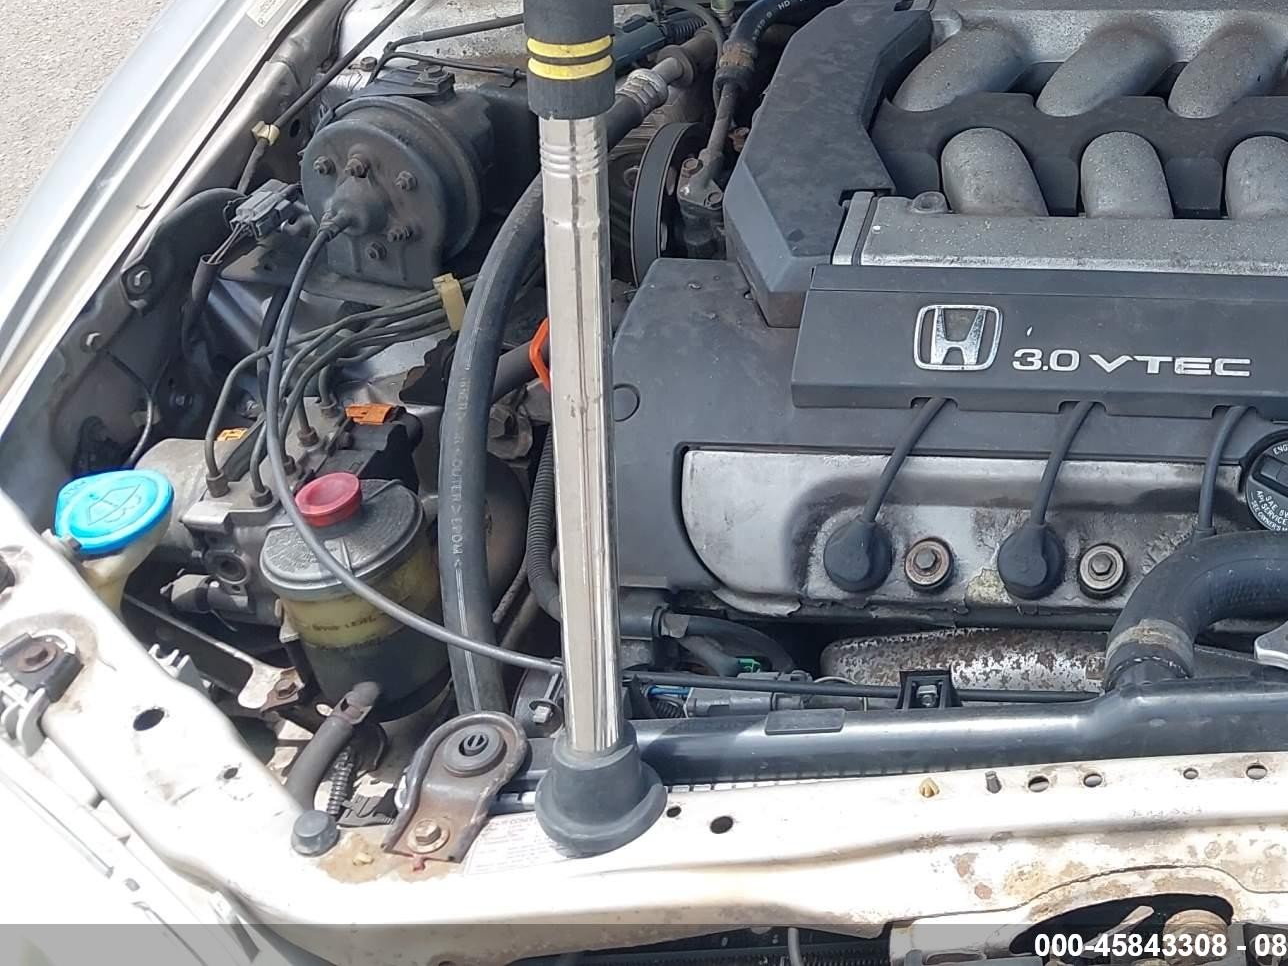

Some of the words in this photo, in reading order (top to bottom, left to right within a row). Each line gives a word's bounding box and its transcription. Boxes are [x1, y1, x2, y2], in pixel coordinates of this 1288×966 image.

[1012, 348, 1081, 372] 3.0
[1089, 353, 1251, 377] VTEC
[1261, 503, 1288, 525] SERVICE
[1265, 495, 1278, 511] SAE
